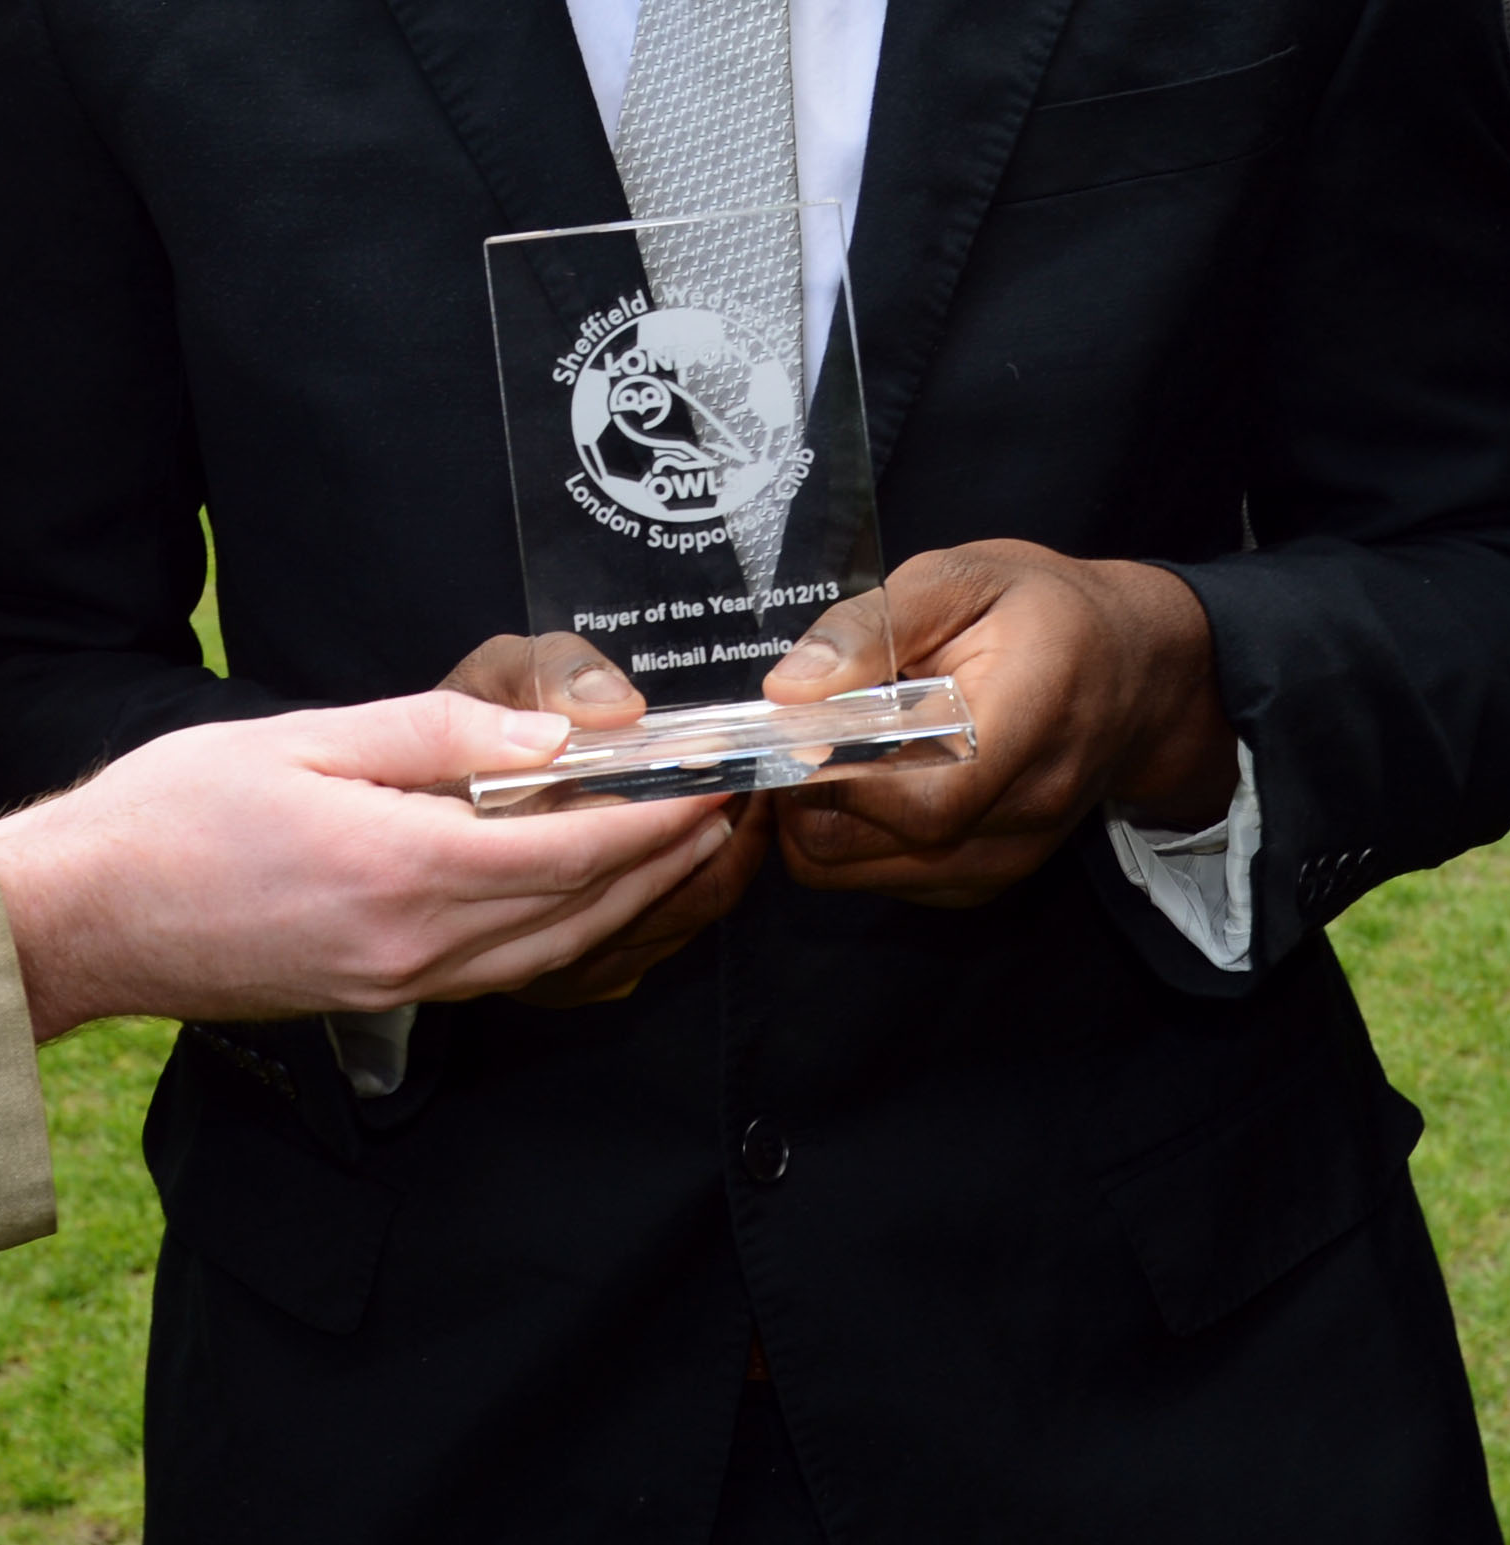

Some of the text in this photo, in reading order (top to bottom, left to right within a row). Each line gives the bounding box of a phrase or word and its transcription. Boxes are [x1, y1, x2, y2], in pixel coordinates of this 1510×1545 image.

[552, 288, 648, 385] Sheffield
[565, 472, 641, 538] London
[775, 448, 815, 500] Club
[574, 582, 840, 633] Player of the Year 2012/13
[631, 637, 793, 673] Michail Antonio
